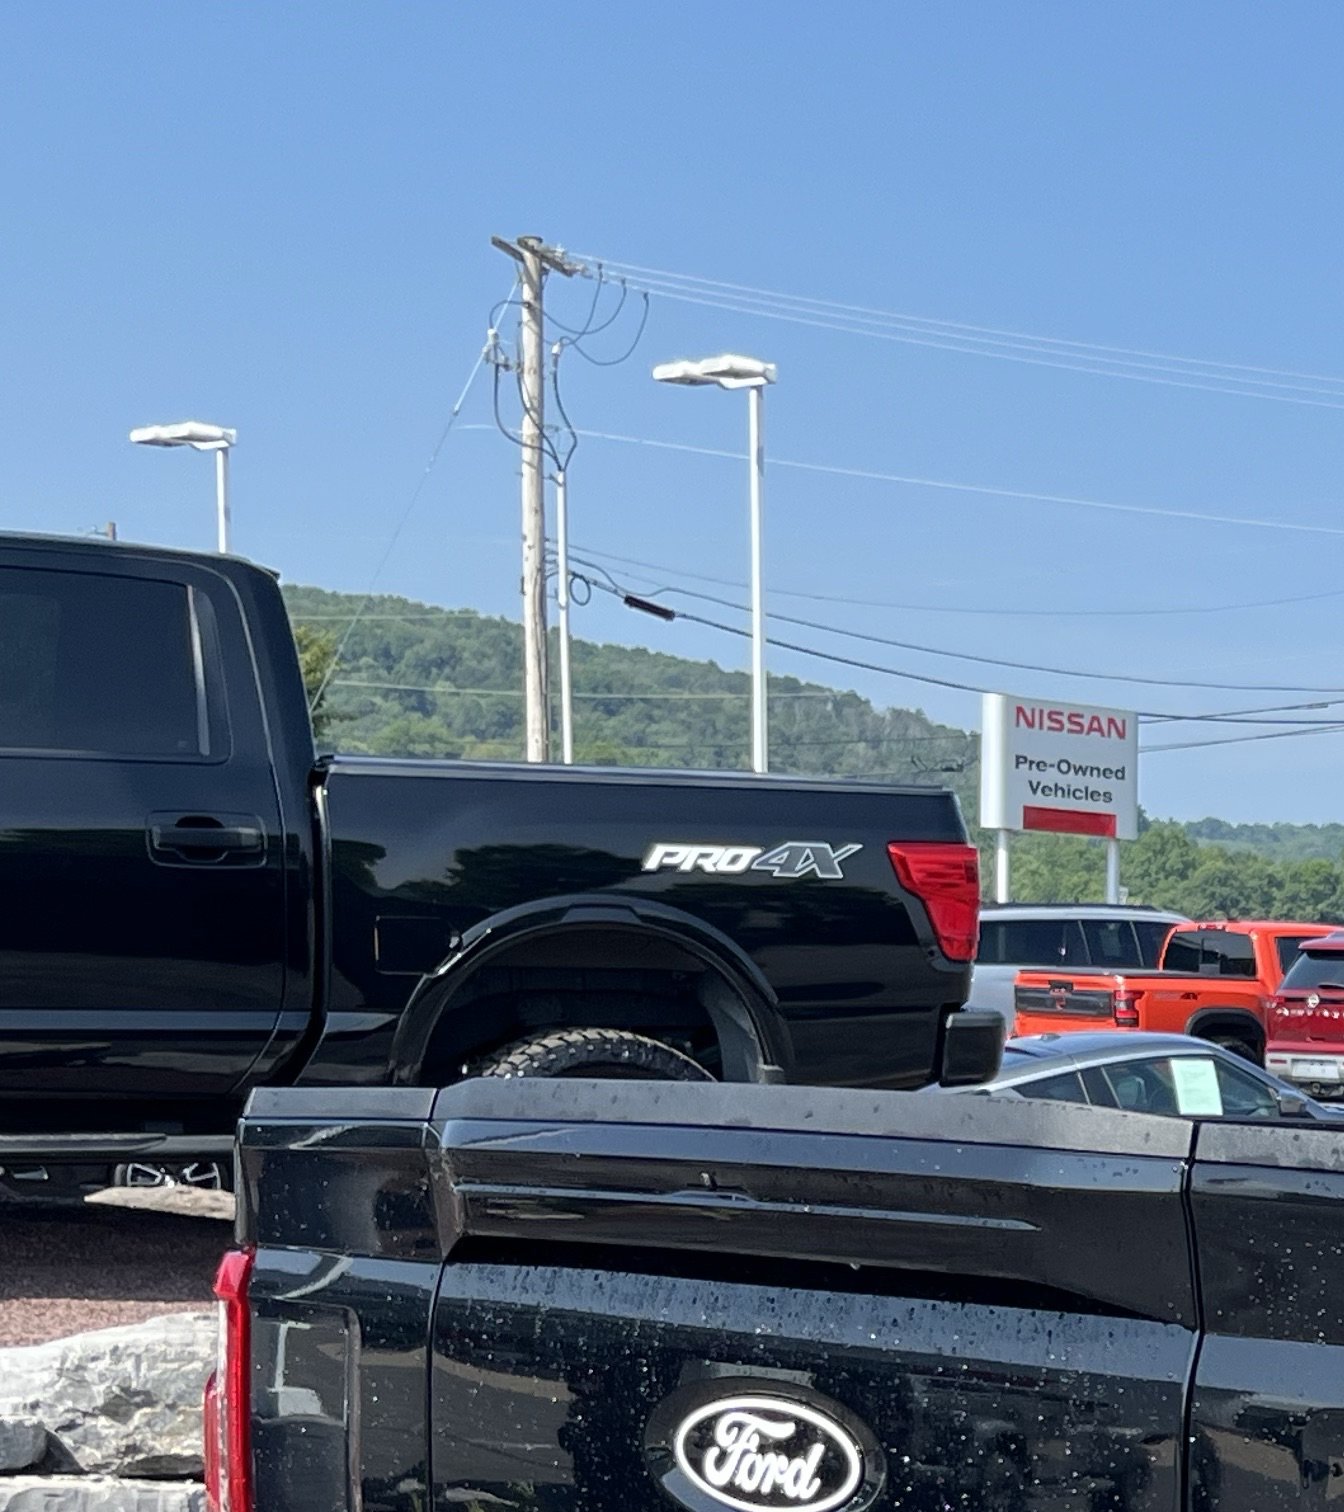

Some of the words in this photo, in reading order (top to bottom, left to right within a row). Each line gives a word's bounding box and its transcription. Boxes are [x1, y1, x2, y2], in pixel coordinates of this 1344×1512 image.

[1015, 705, 1127, 740] NISSAN
[1014, 754, 1126, 781] Pre-Owned
[1028, 780, 1113, 804] Vehicles
[703, 1410, 826, 1500] Ford
